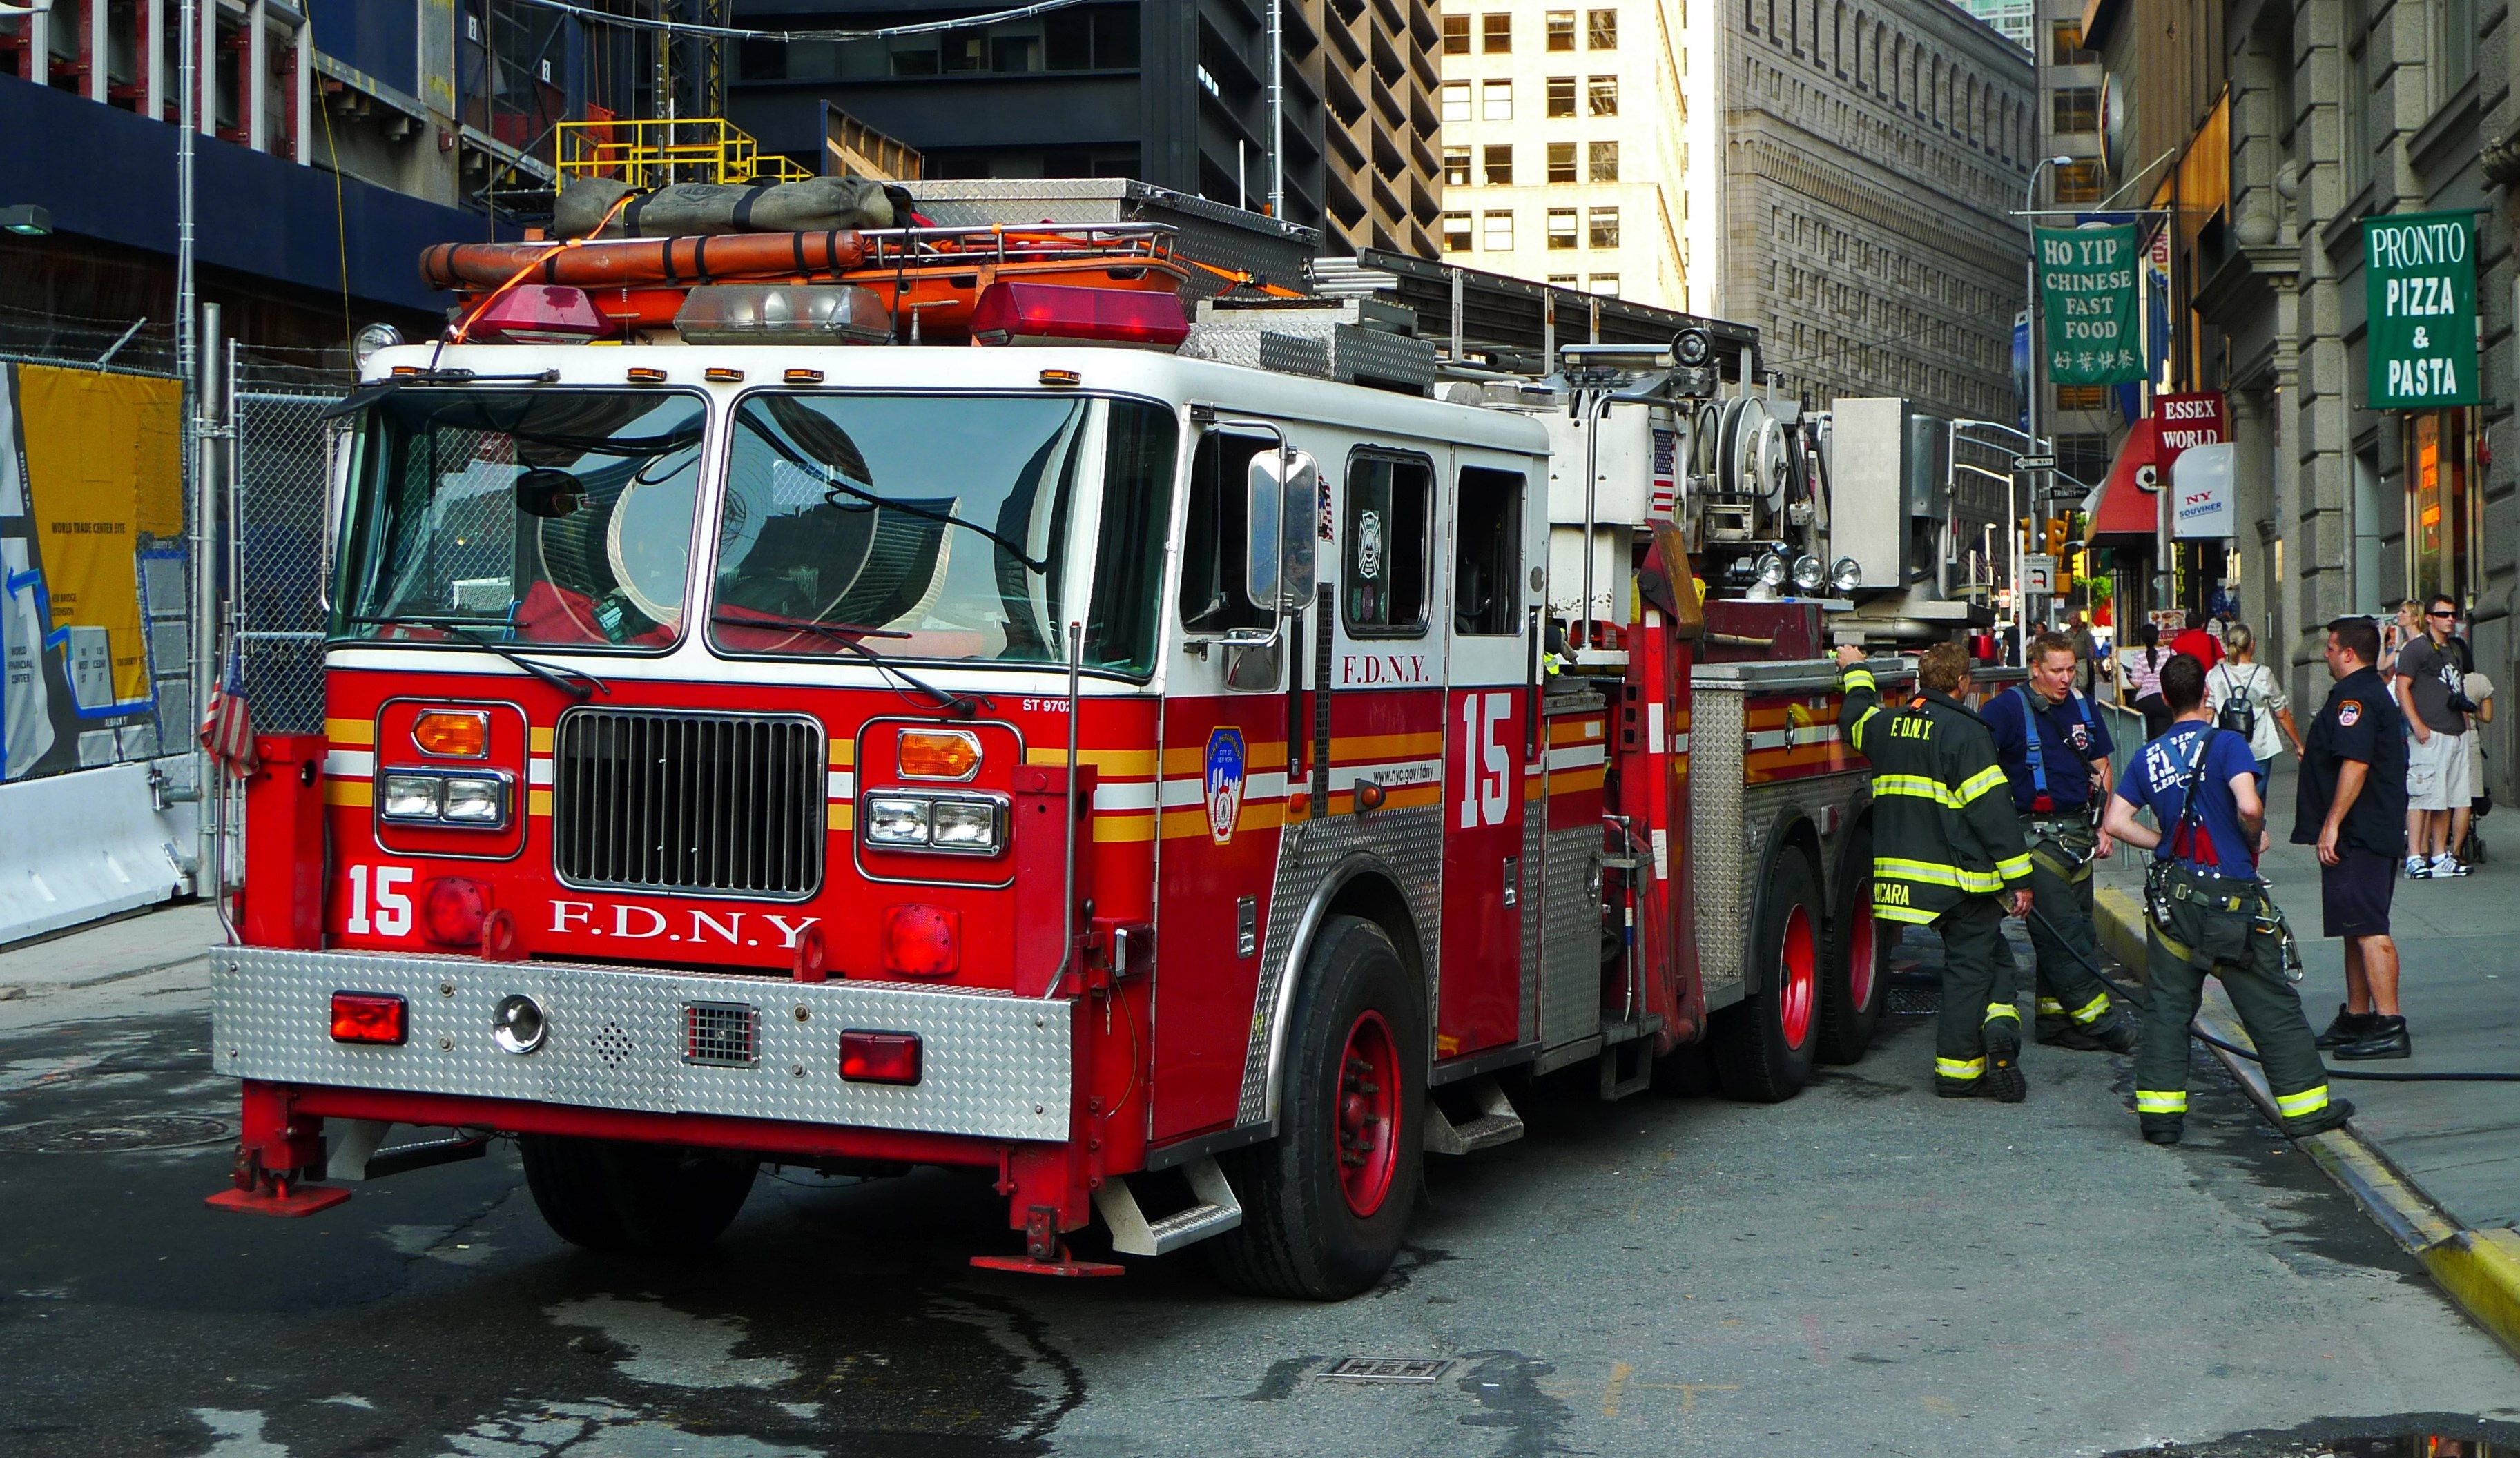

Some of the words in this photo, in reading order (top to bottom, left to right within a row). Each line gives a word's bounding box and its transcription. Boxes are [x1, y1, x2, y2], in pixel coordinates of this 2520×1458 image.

[2044, 239, 2073, 266] HO
[2079, 238, 2117, 266] YIP
[2371, 222, 2465, 269] PRONTO
[2046, 271, 2131, 291] CHINESE
[2066, 296, 2114, 315] FAST
[2387, 277, 2455, 317] PIZZA
[2065, 320, 2118, 339] FOOD
[2412, 326, 2430, 349] &
[2387, 358, 2458, 397] PASTA
[2164, 400, 2217, 420] ESSEX
[2162, 429, 2218, 449] WORLD
[2185, 490, 2213, 505] NY
[2179, 502, 2222, 518] SOUVINER
[52, 522, 72, 533] WORLD
[74, 522, 92, 533] TRADE
[93, 523, 112, 534] CENTER
[114, 523, 126, 534] SITE
[1342, 655, 1430, 683] F.D.N.Y.
[1022, 699, 1040, 712] ST
[1460, 692, 1511, 829] 15
[1373, 762, 1434, 786] www.nyc.gov/fdny
[348, 864, 414, 937] 15
[547, 899, 822, 949] F.D.N.Y
